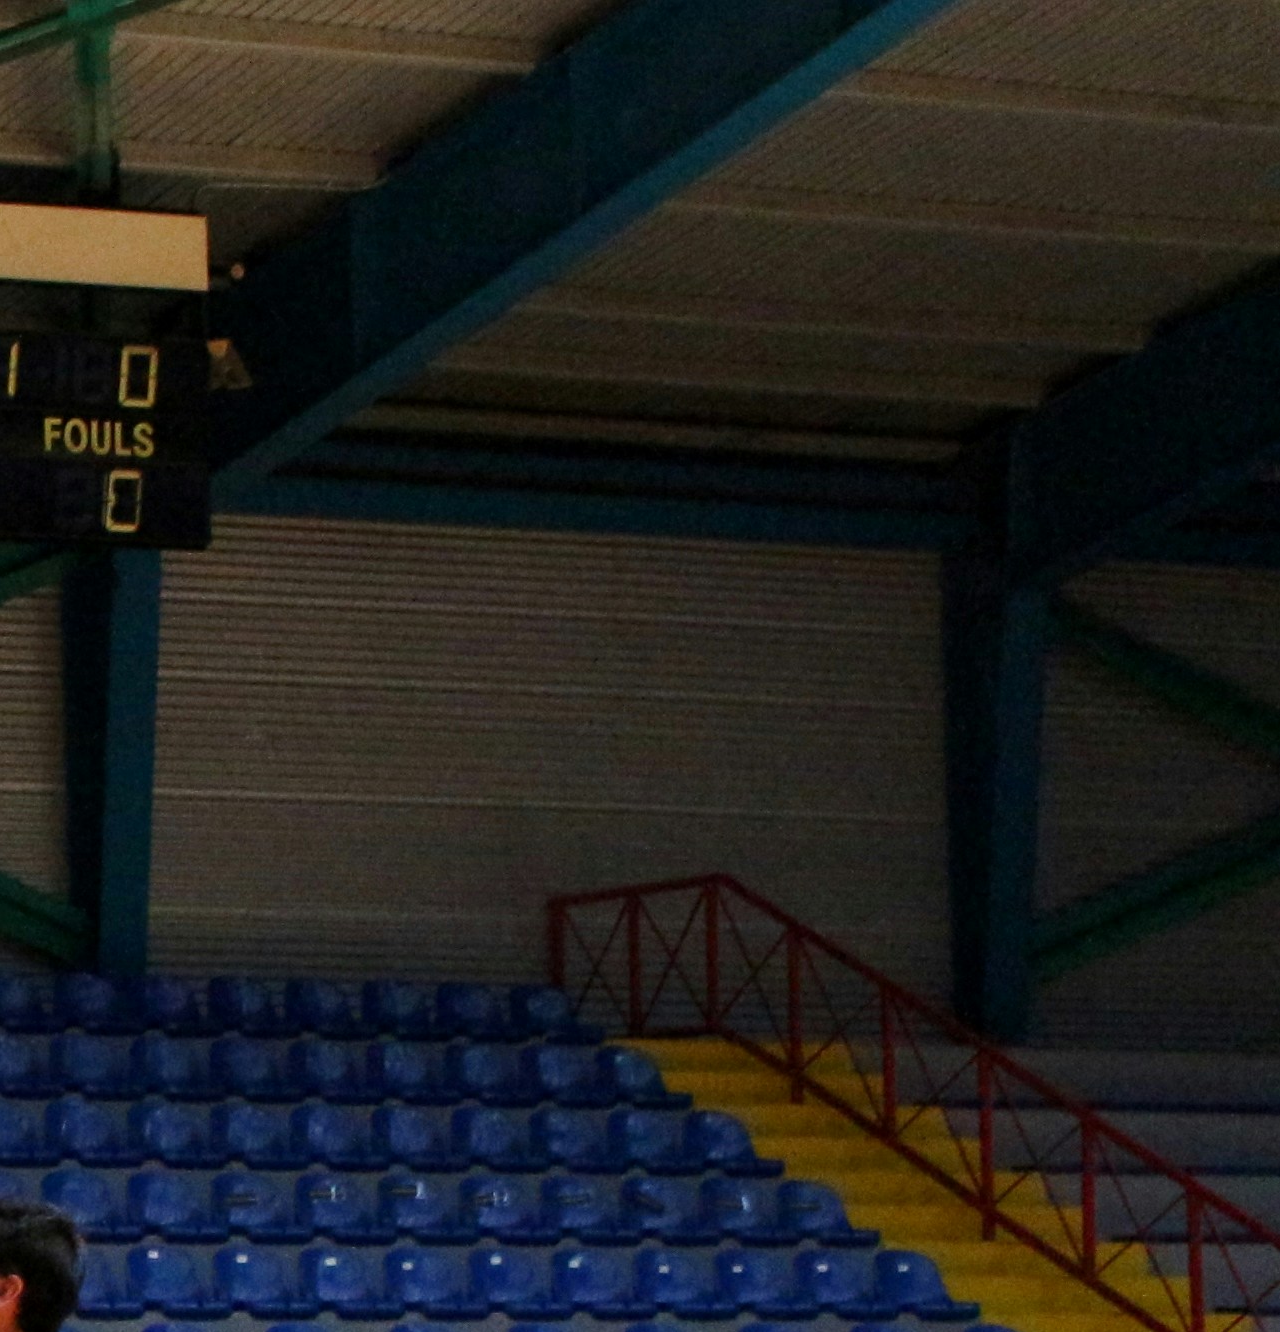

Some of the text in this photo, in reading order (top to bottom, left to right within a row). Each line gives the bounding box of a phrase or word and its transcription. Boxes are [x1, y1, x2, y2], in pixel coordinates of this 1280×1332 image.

[7, 341, 20, 398] 1
[118, 345, 159, 408] 0
[43, 416, 156, 459] FOULS
